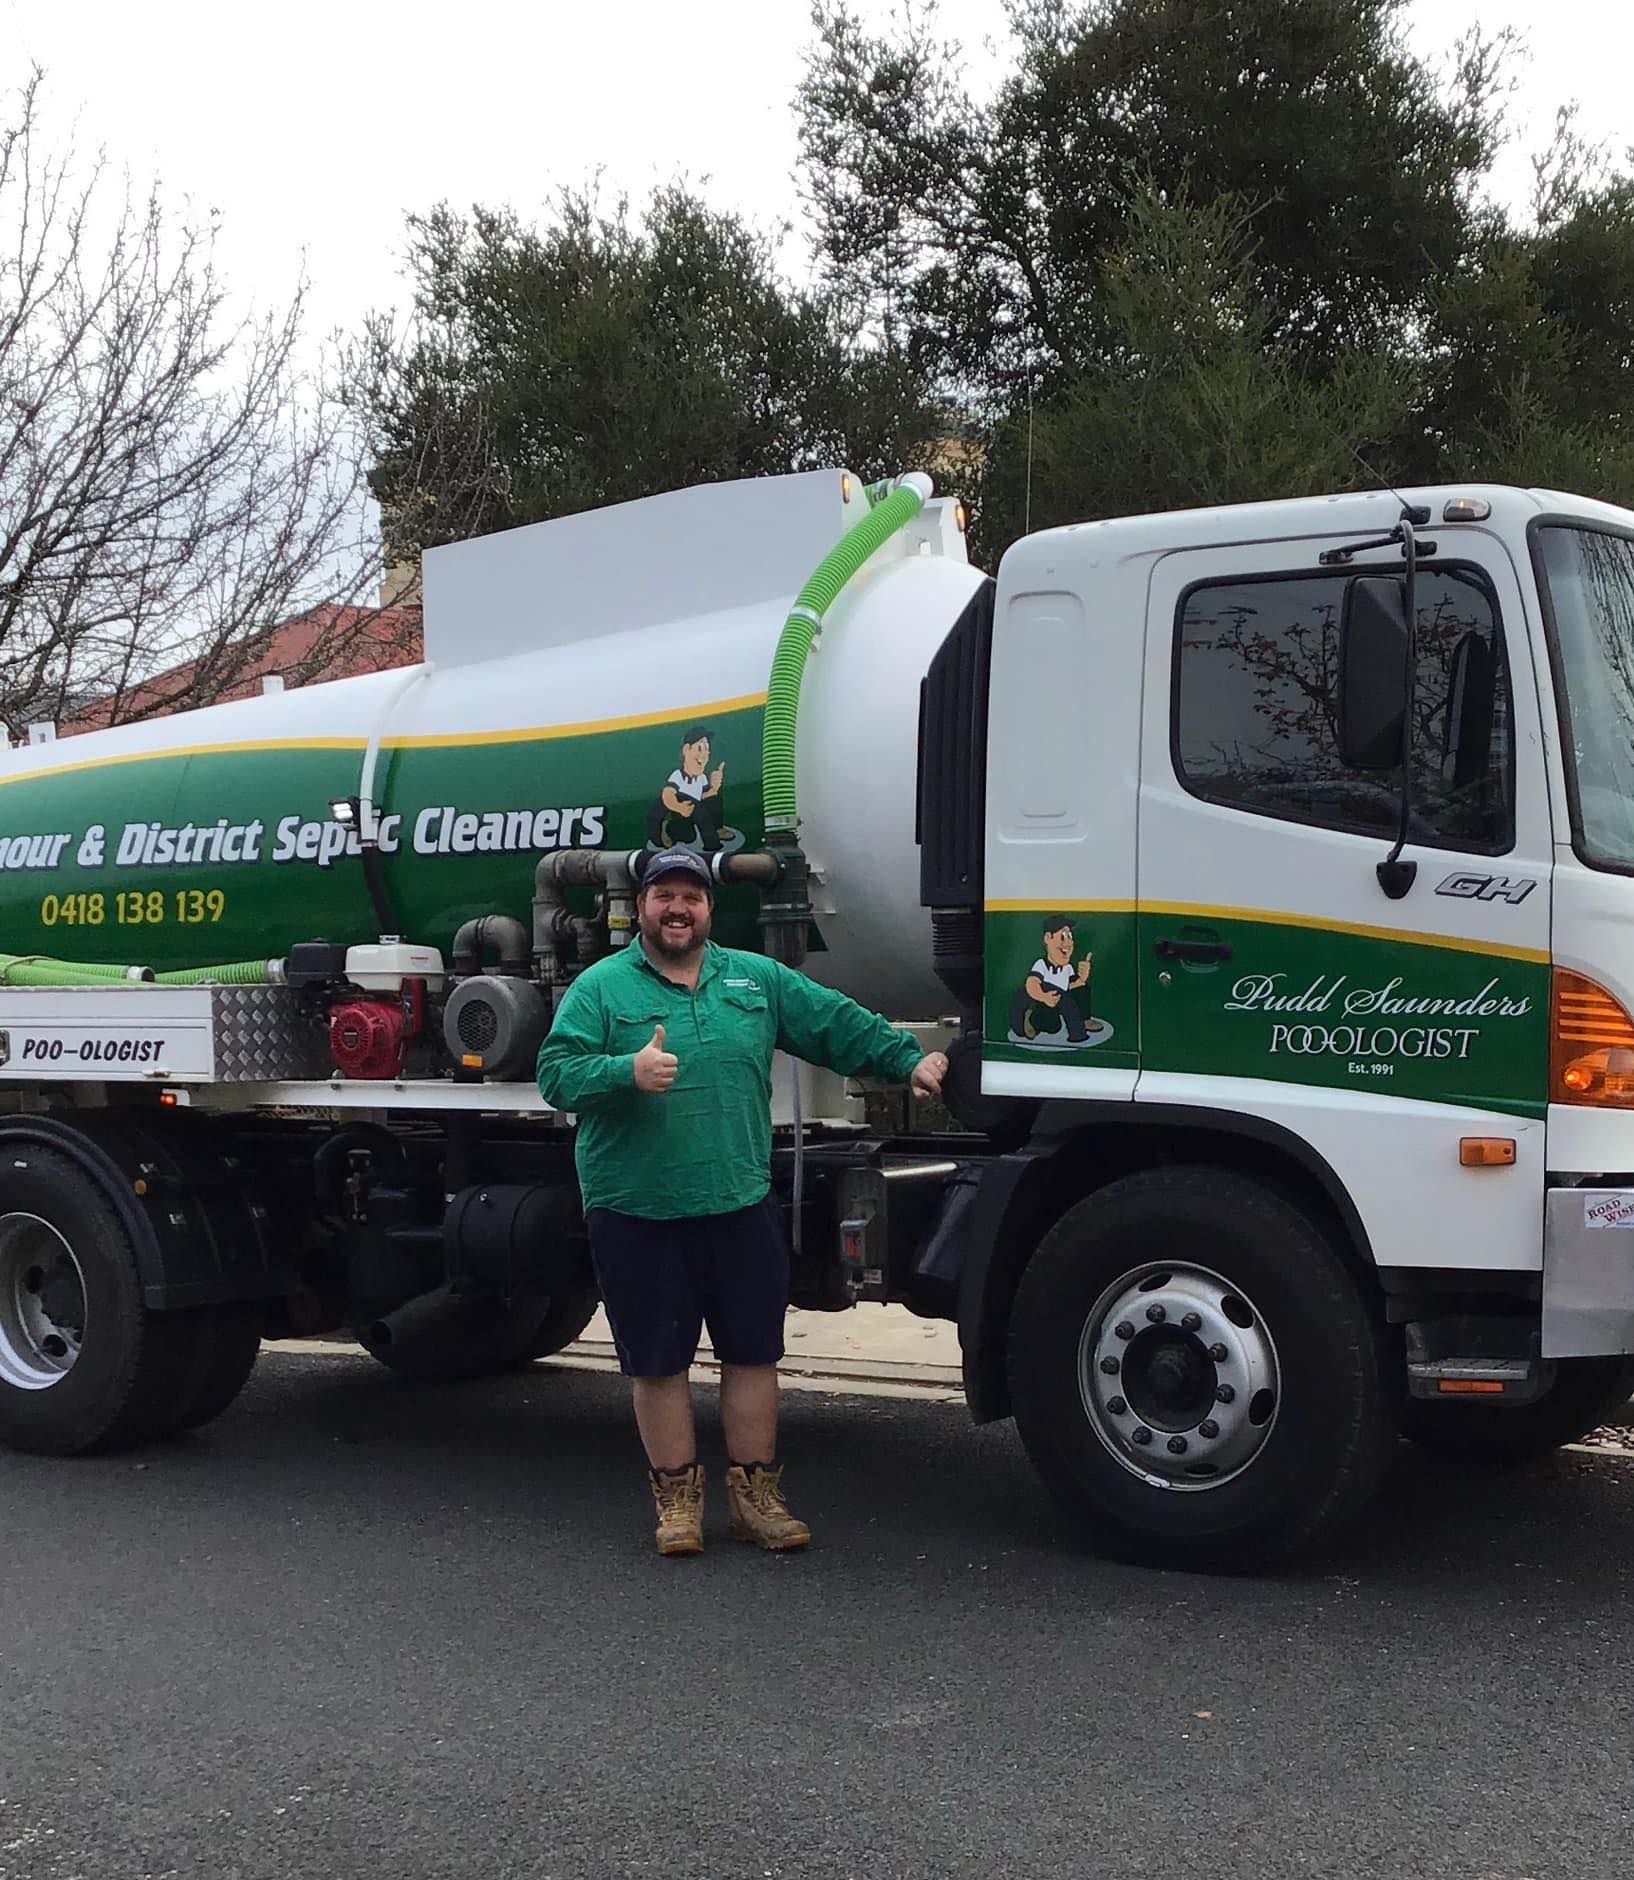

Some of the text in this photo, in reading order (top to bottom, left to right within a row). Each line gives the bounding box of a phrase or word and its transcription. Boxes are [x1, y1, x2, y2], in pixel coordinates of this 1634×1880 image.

[77, 824, 105, 866] &
[115, 818, 264, 865] District
[413, 806, 605, 854] Cleaners
[1434, 872, 1537, 905] GH
[41, 889, 226, 926] 0418 138 139
[1223, 973, 1533, 1020] Pudd Saunders
[22, 1038, 166, 1062] POO-OLOGIST
[1347, 1062, 1395, 1076] Est. 1991
[1588, 1199, 1620, 1220] ROAD
